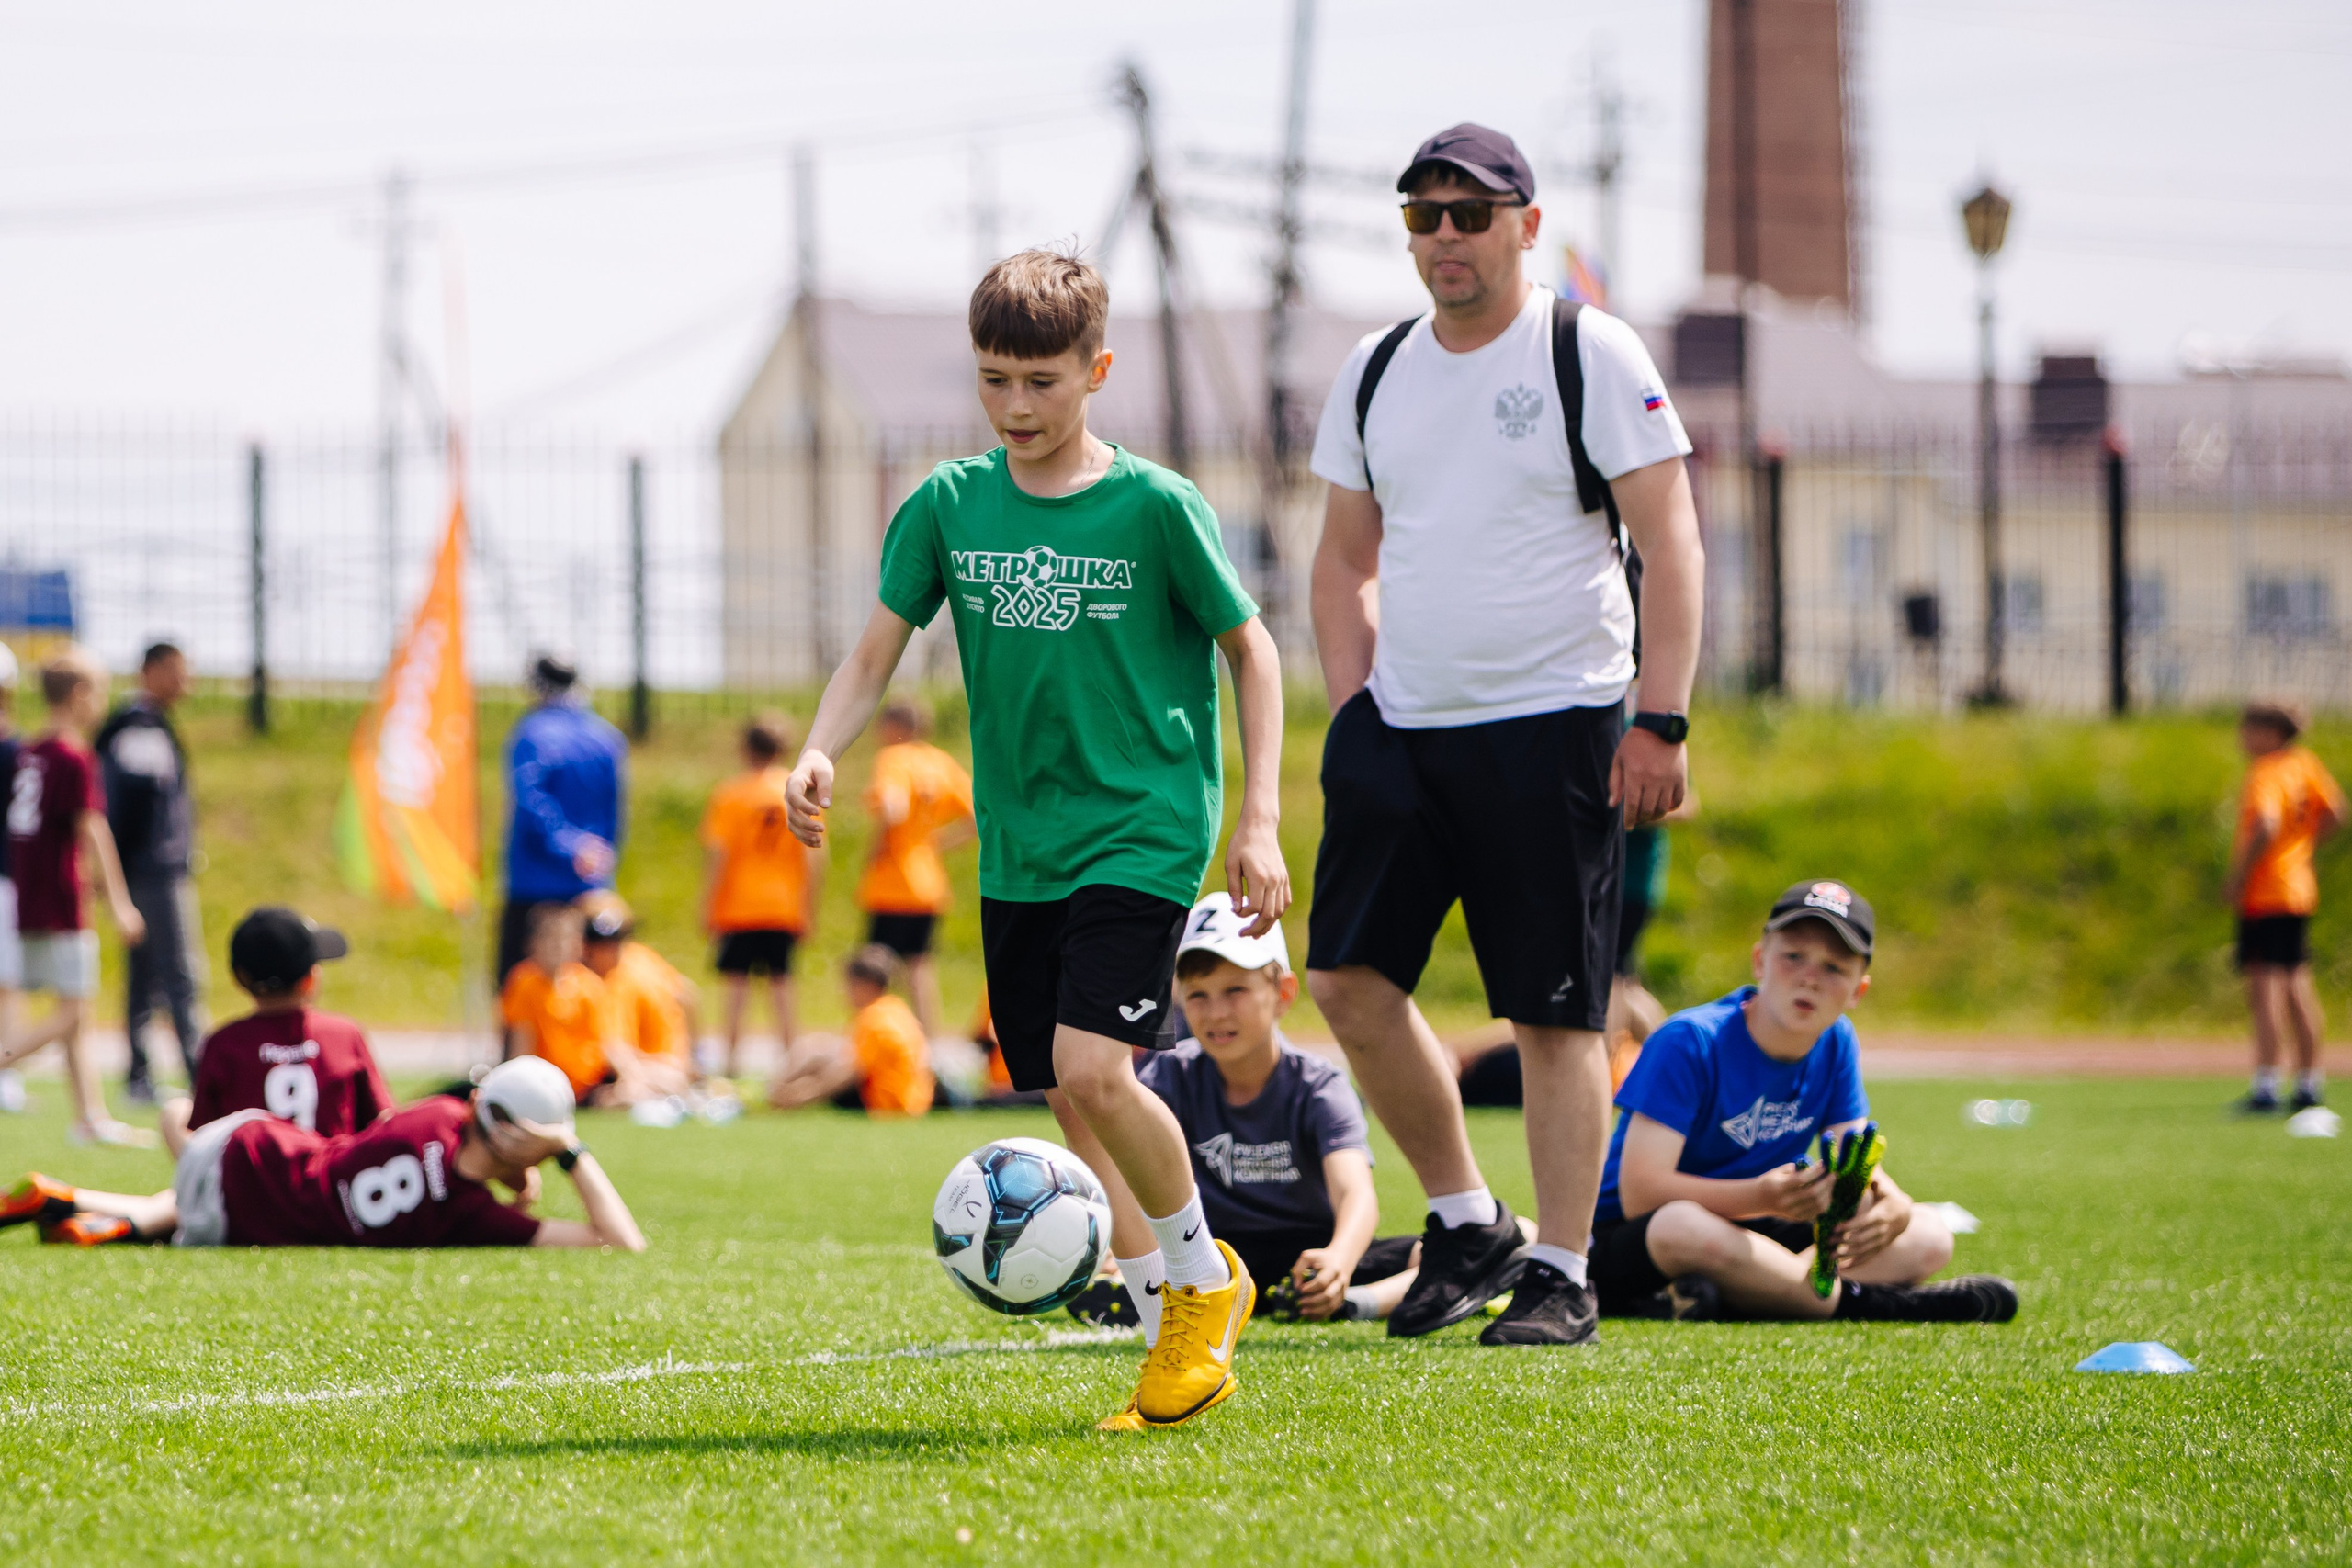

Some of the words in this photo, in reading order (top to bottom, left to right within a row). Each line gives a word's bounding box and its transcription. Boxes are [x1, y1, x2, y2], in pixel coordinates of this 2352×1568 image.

[991, 585, 1081, 631] 2025
[1086, 603, 1128, 611] ДВОРОВОГО
[1086, 611, 1120, 620] ФУТБОЛА
[264, 1062, 319, 1133] 9
[350, 1154, 426, 1228] 8
